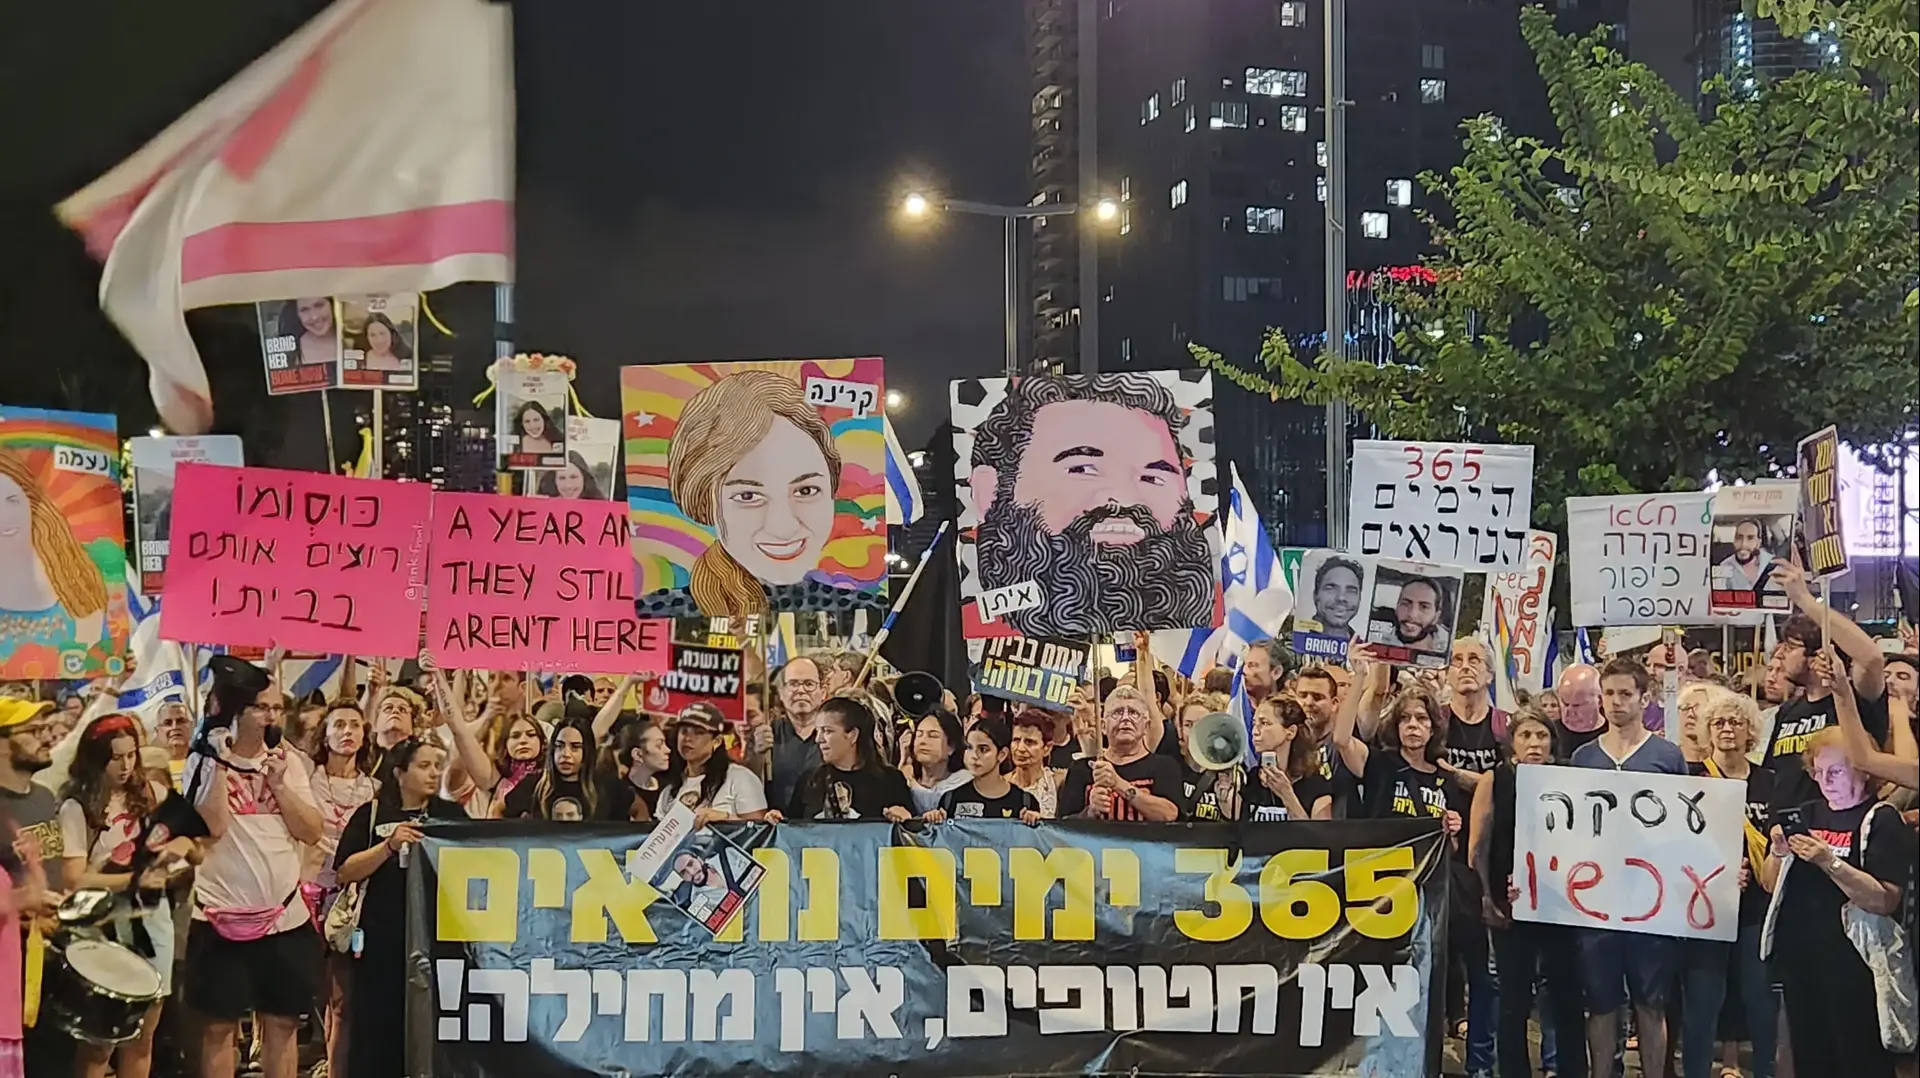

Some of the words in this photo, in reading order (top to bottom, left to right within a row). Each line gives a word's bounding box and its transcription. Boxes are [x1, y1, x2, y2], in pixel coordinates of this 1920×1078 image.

[268, 353, 288, 369] HER
[810, 384, 873, 416] קרינה
[58, 450, 108, 472] נעמה
[1403, 446, 1485, 483] 365
[1374, 481, 1515, 518] הימים
[448, 505, 473, 540] A
[488, 507, 586, 546] YEAR
[598, 511, 632, 548] AN
[1361, 521, 1526, 565] הנוראים
[188, 531, 277, 566] אותם
[305, 542, 401, 573] רוצים
[441, 560, 536, 601] THEY
[556, 566, 635, 602] STIL
[1599, 565, 1681, 590] כיפור
[210, 576, 363, 632] בבית!
[982, 585, 1033, 621] איתן
[443, 612, 561, 653] AREN'T
[571, 616, 661, 656] HERE
[1305, 637, 1338, 654] BRING
[721, 652, 741, 671] לא
[1040, 642, 1084, 677] אתם
[713, 674, 740, 694] לא
[1045, 672, 1078, 704] הם
[663, 818, 680, 837] מתן
[1539, 789, 1707, 838] עסקה
[650, 833, 667, 853] עדיין
[436, 847, 840, 943] נואים
[878, 846, 1141, 942] ימים
[1173, 847, 1419, 942] 365
[1526, 850, 1726, 930] עכשיו
[436, 957, 756, 1042] מחילה!
[774, 965, 905, 1052] אין
[924, 963, 1279, 1051] חטופים,
[1298, 962, 1421, 1047] אין
